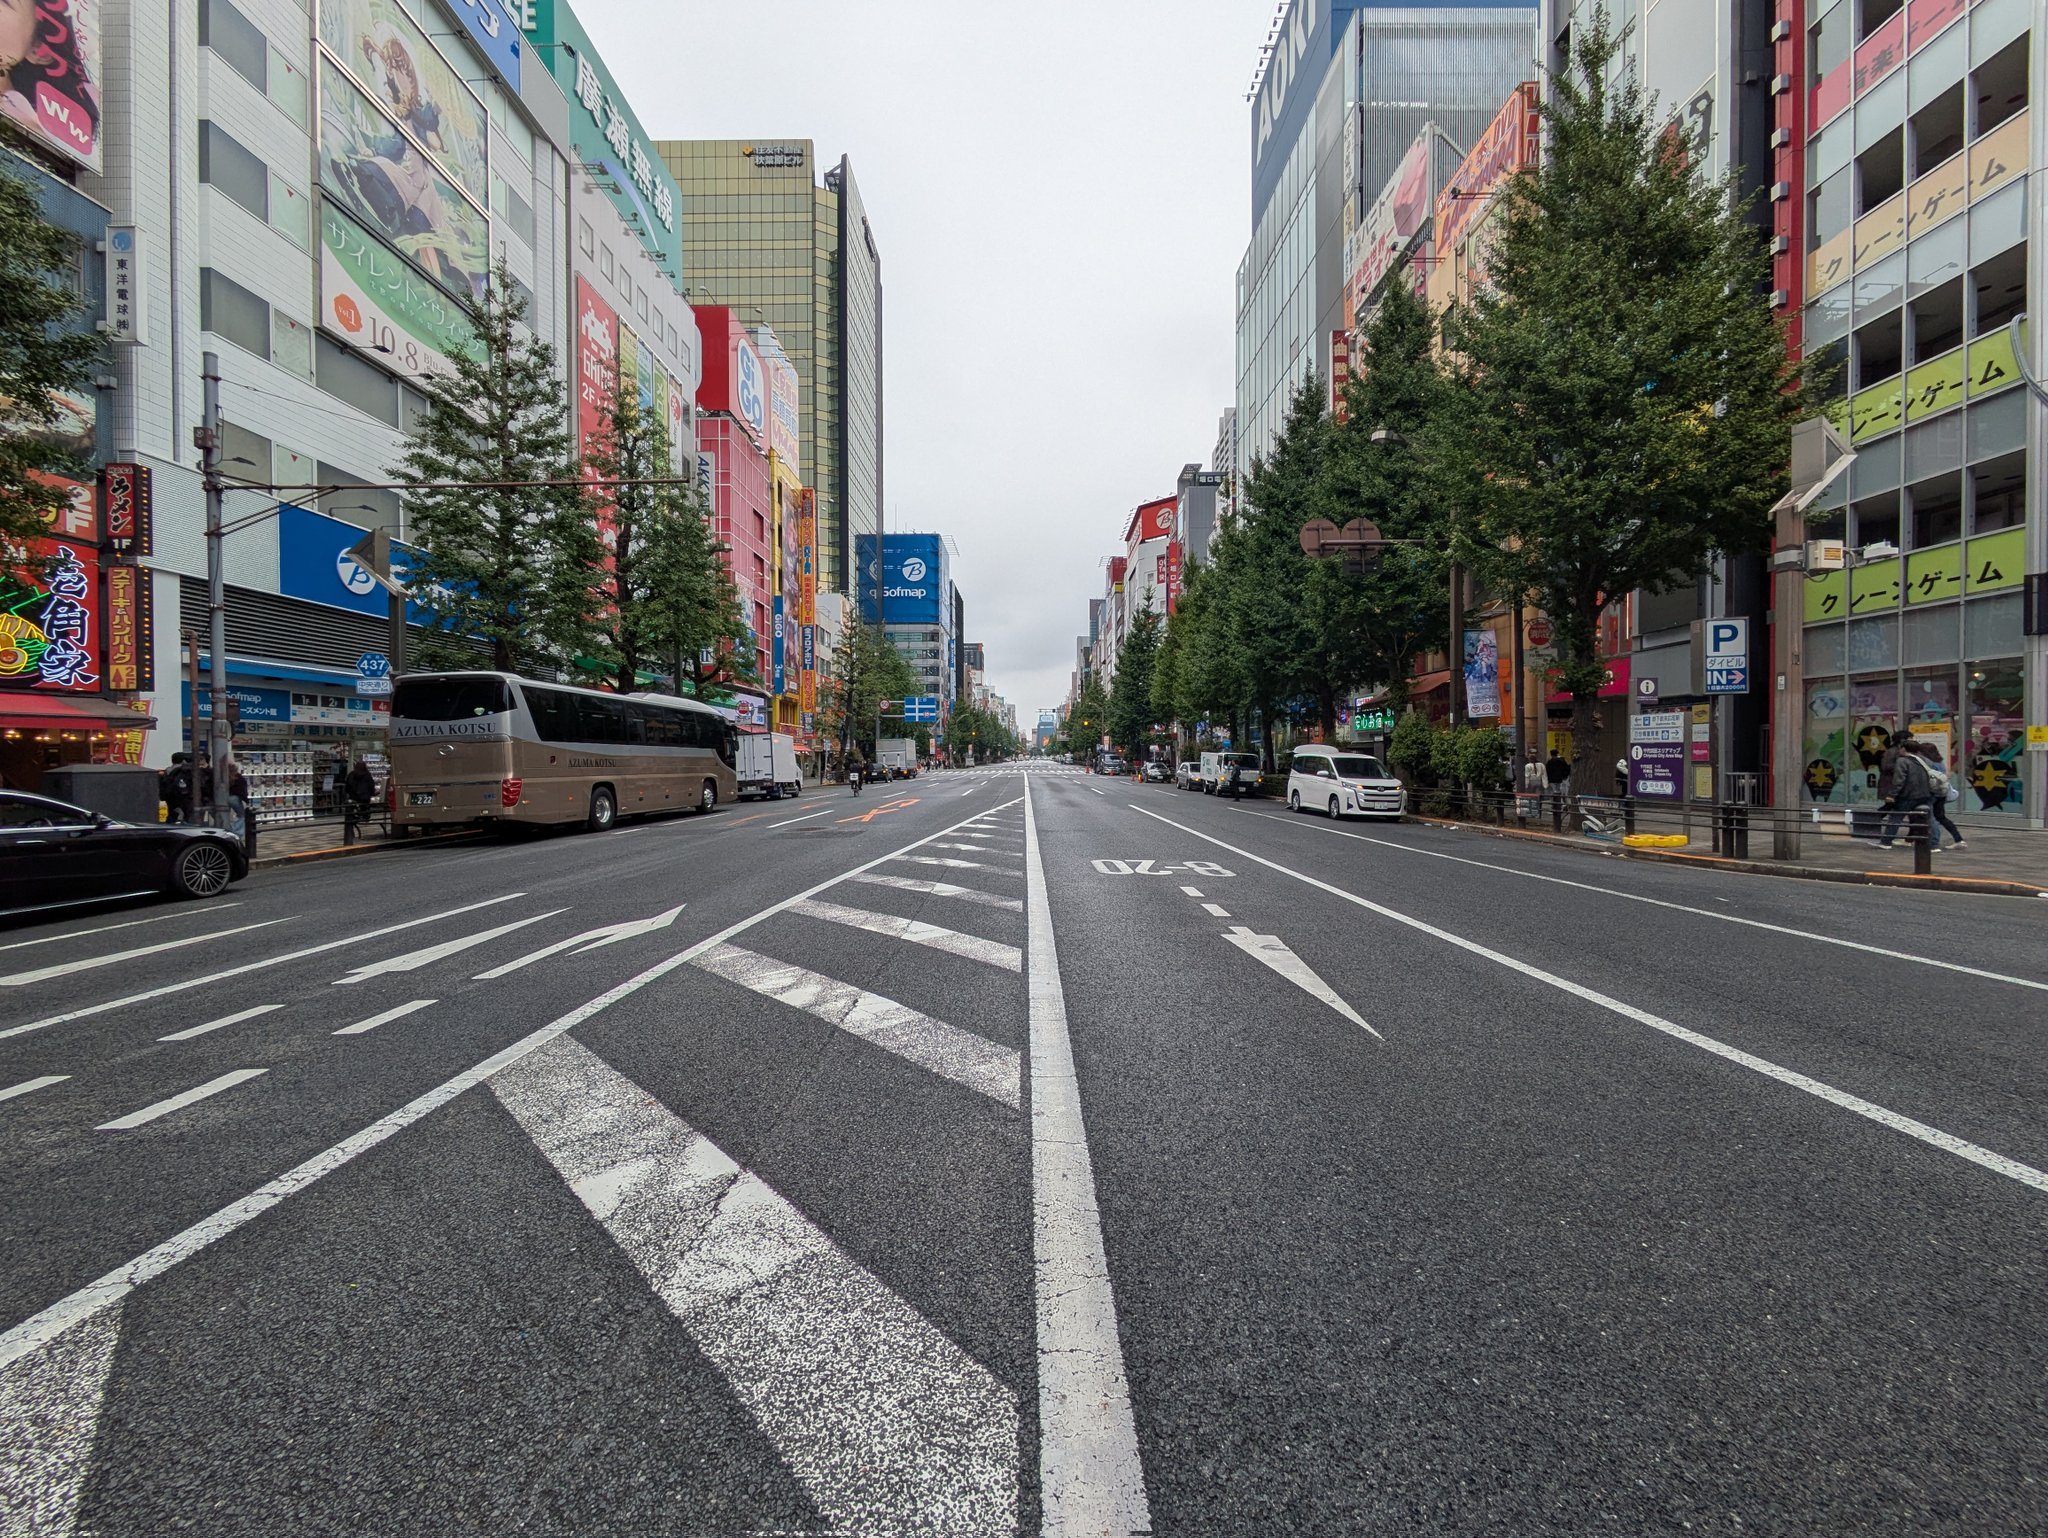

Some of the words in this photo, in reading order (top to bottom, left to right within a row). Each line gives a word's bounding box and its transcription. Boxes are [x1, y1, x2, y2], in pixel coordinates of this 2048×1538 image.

[1848, 0, 1963, 90] 音楽ゲー
[1825, 158, 2006, 280] クレーンゲーム
[369, 316, 418, 371] 10.8
[1836, 361, 2006, 437] レーンゲーム
[112, 538, 132, 550] 1F
[1820, 561, 2003, 614] クレーンゲーム
[1712, 624, 1739, 652] P
[360, 660, 386, 670] 437
[1708, 657, 1744, 668] ダイビル
[125, 666, 137, 689] 2F
[1707, 671, 1727, 685] IN
[396, 724, 444, 737] AZUMA
[448, 722, 496, 735] KOTSU
[568, 758, 593, 768] AZUMA
[593, 758, 617, 768] KOTSU
